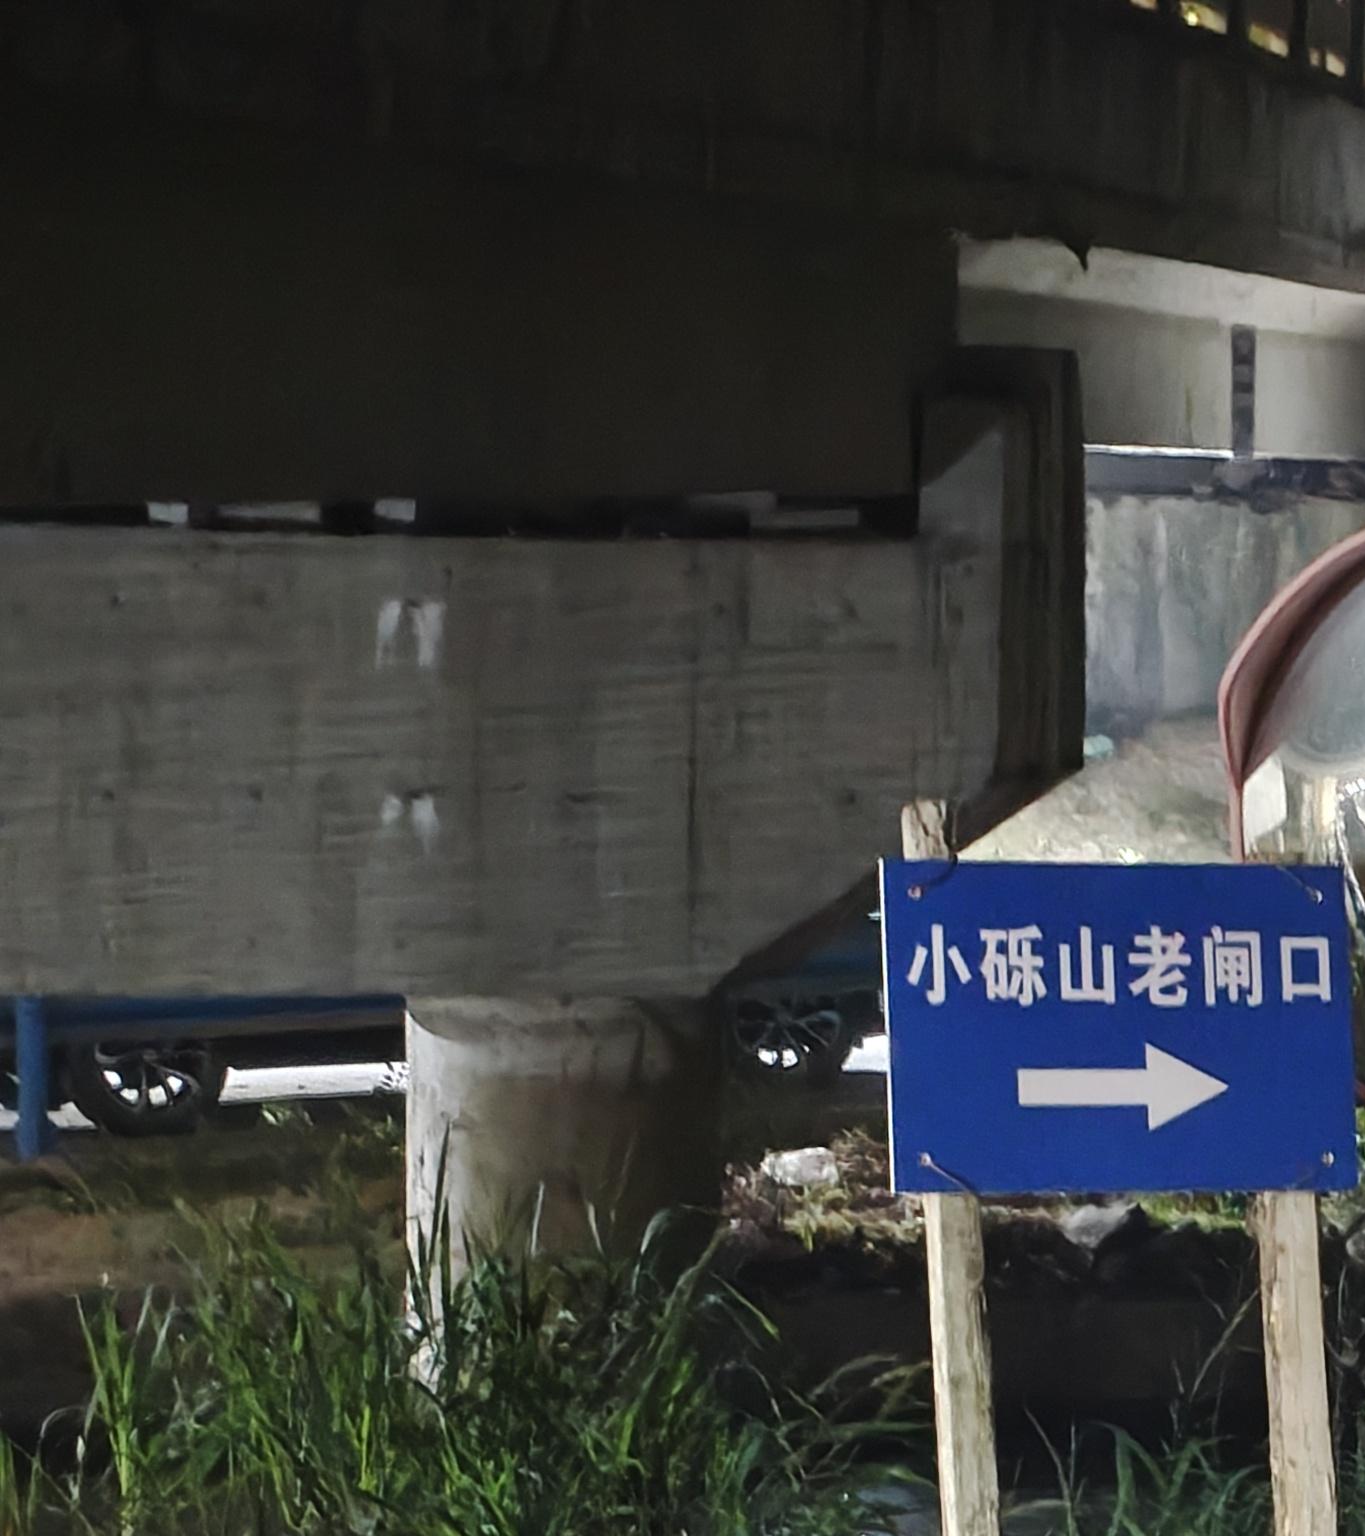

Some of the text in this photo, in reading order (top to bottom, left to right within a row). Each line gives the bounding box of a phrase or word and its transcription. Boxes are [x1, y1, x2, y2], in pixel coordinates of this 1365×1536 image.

[905, 923, 1332, 1008] 小砾山老闸口
